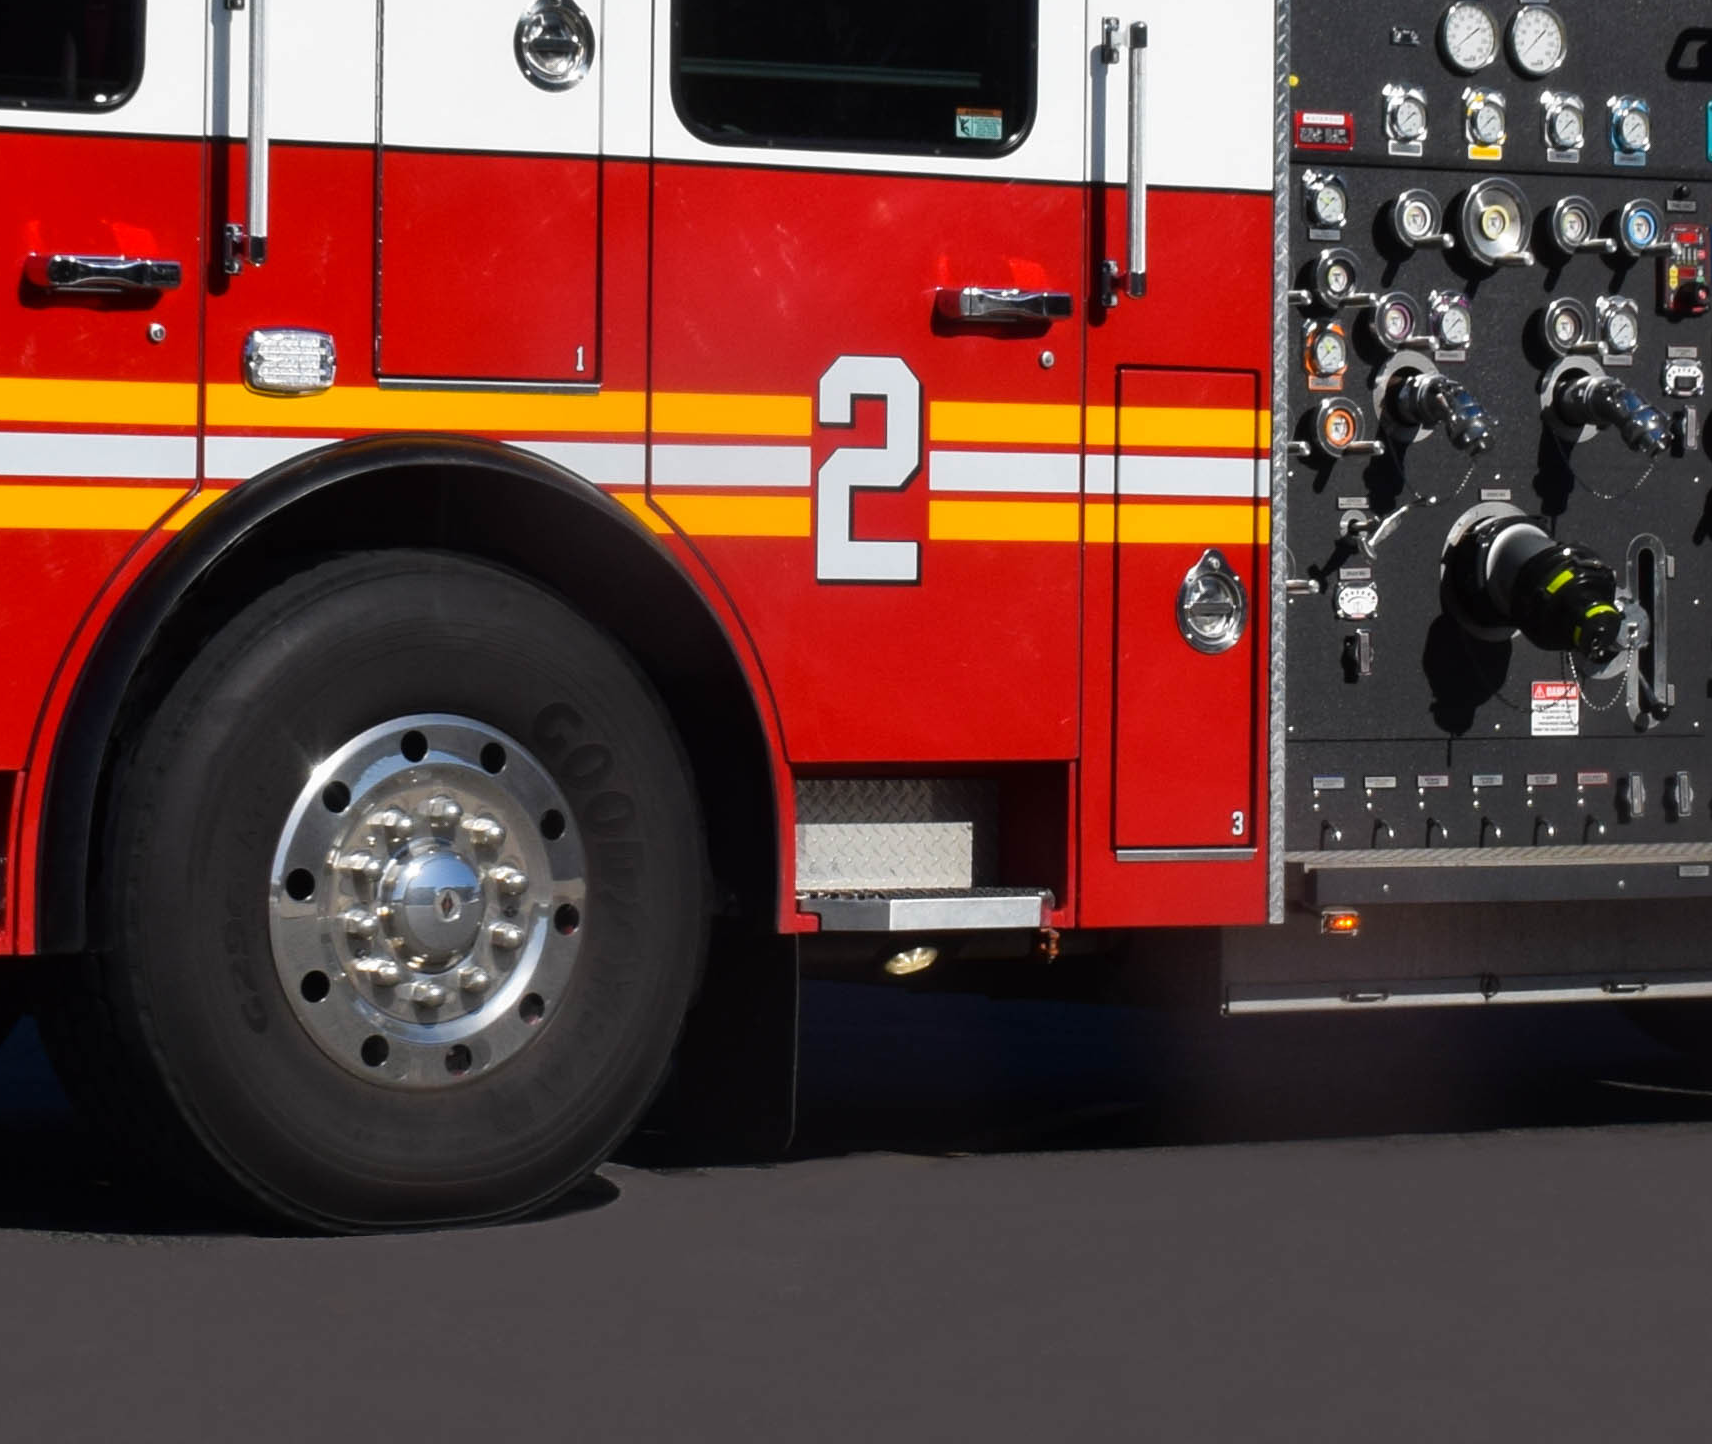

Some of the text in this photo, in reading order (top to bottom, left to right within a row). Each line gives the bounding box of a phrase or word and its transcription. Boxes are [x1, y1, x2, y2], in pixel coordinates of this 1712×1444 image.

[575, 346, 585, 372] 1
[817, 355, 922, 584] 2
[1232, 811, 1244, 836] 3
